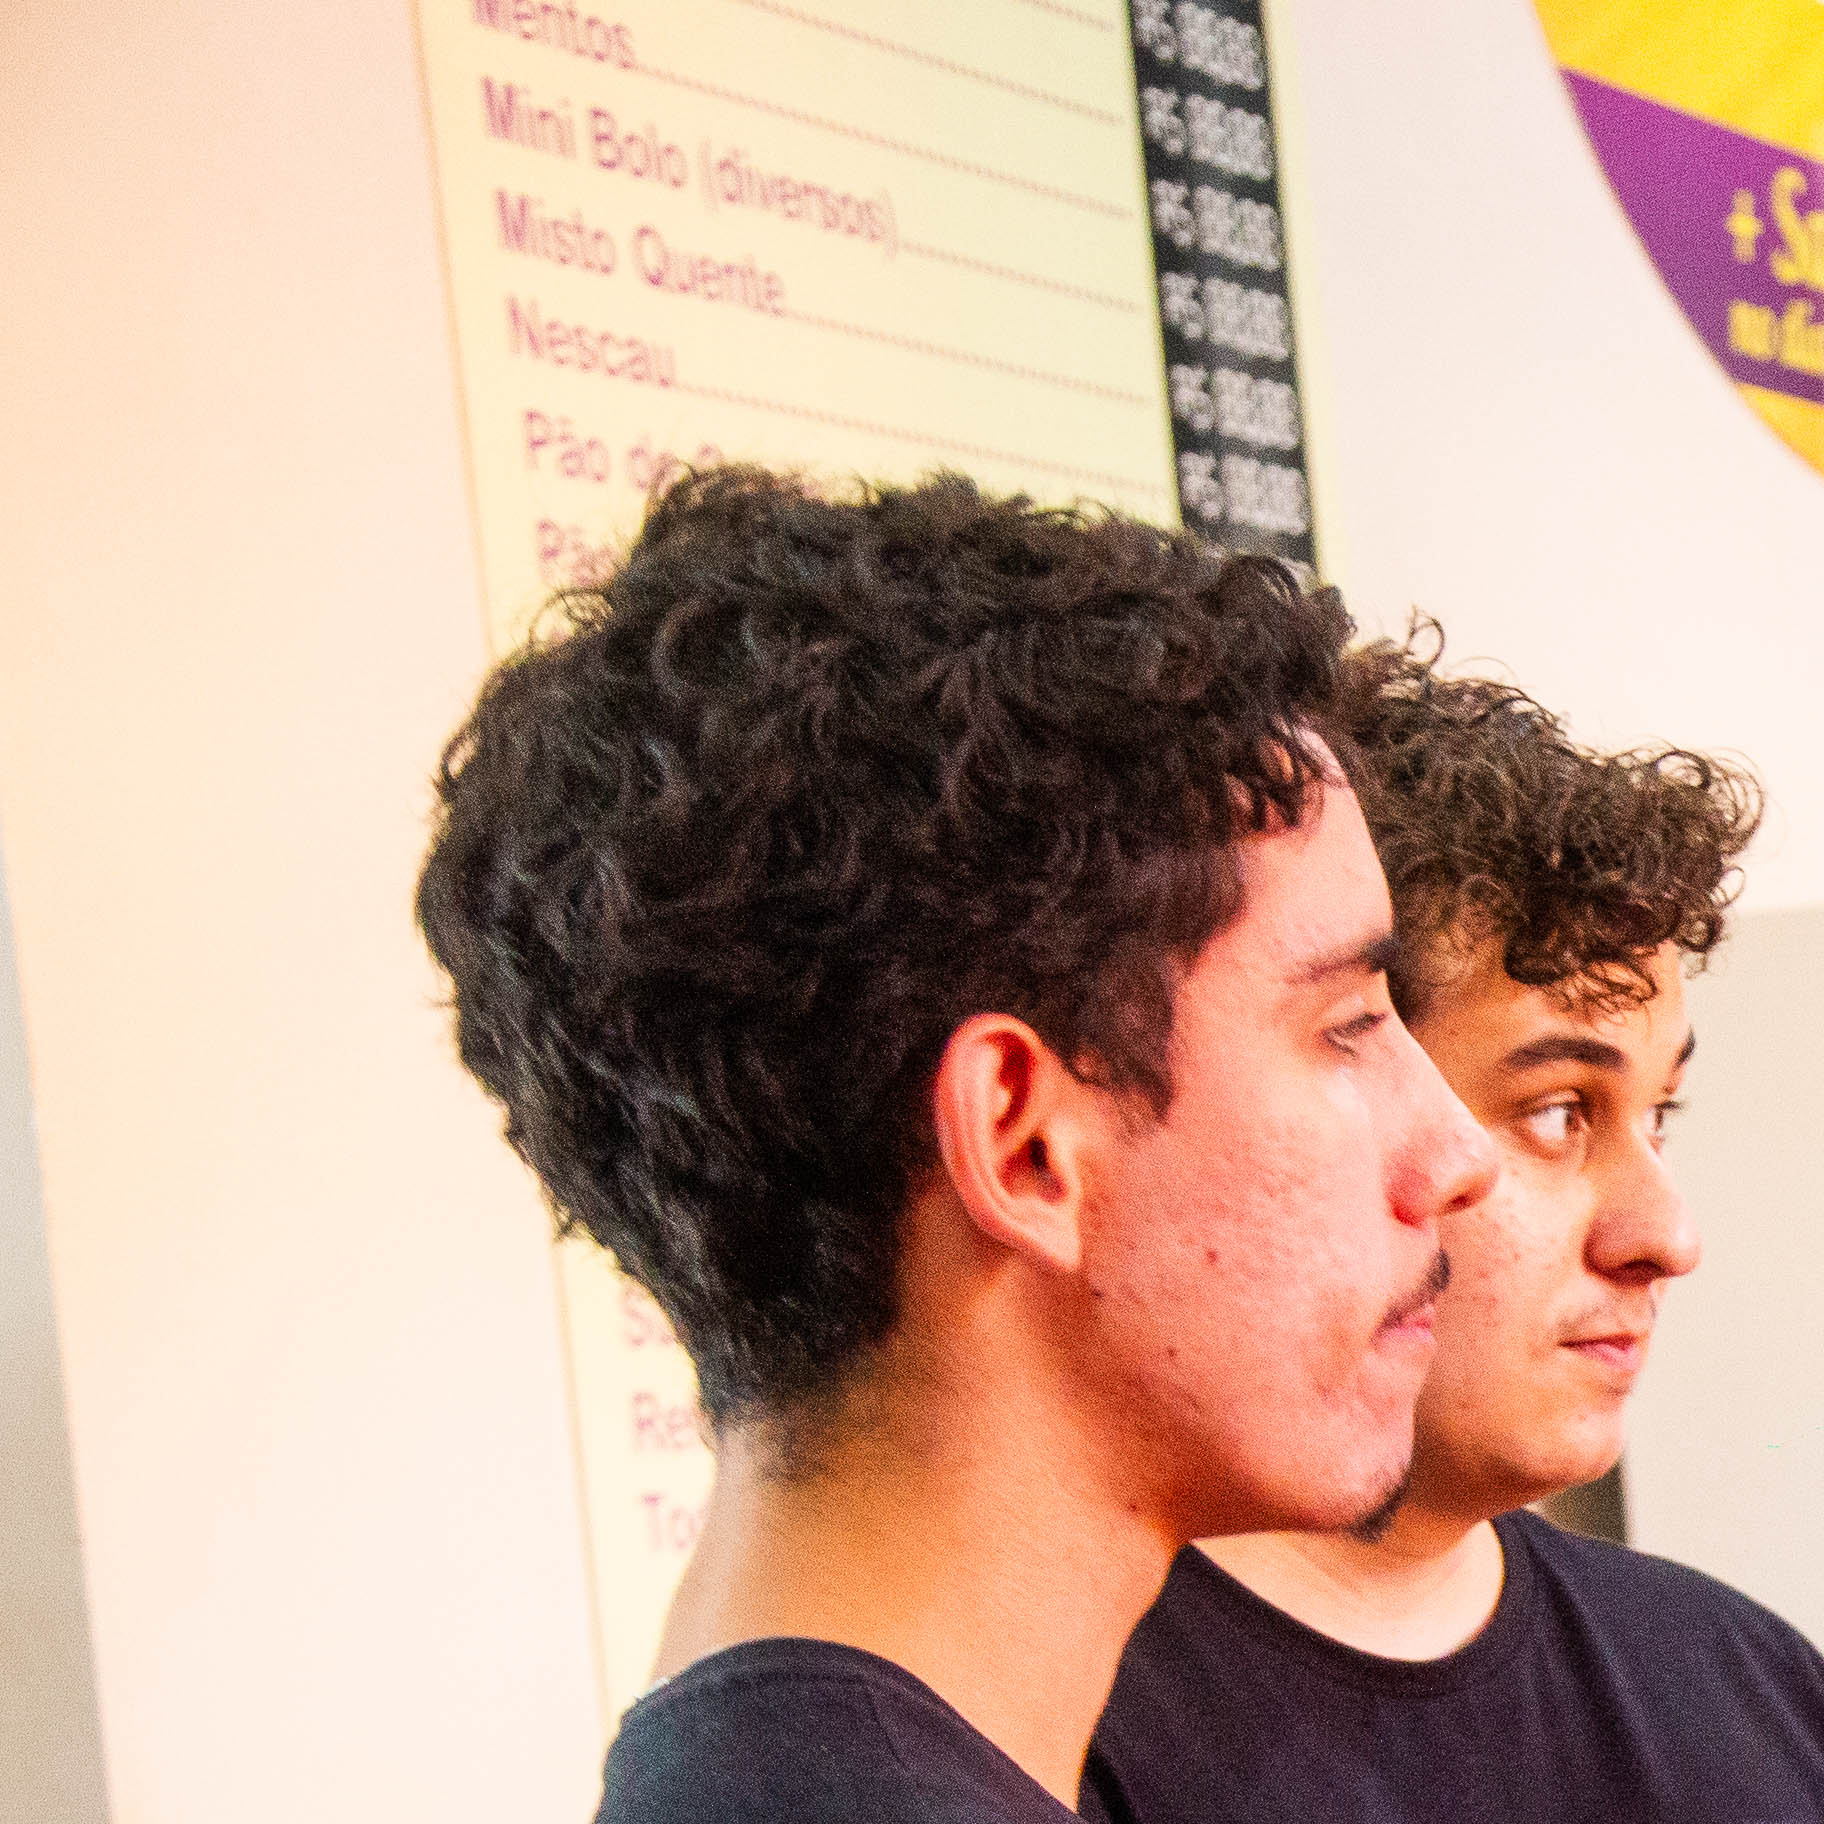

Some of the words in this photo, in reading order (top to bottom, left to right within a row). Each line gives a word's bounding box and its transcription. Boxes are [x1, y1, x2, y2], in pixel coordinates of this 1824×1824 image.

[480, 75, 577, 161] Mini
[587, 106, 688, 192] Bolo
[698, 138, 900, 260] (diversos)
[494, 188, 617, 275] Misto
[630, 224, 789, 319] Quente
[506, 294, 678, 390] Nescau
[523, 407, 610, 482] Pão
